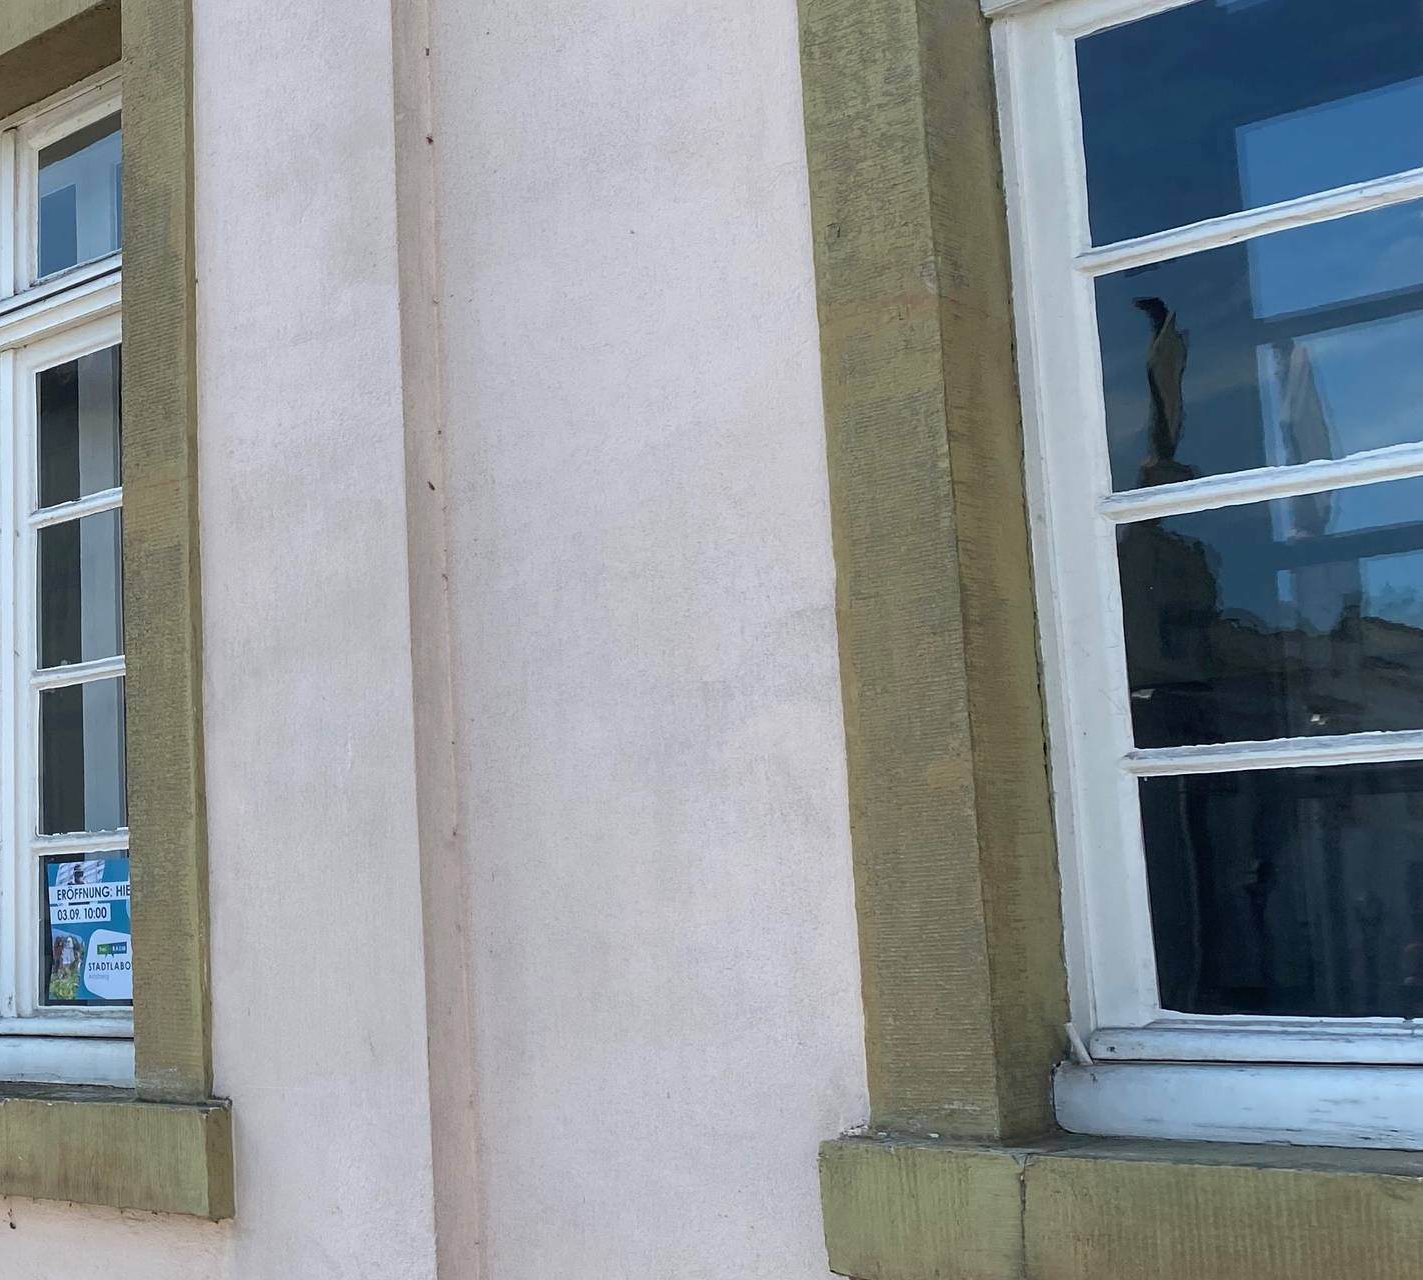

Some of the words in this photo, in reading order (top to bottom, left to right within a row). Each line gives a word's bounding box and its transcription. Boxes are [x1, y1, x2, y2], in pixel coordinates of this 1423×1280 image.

[57, 885, 113, 901] ERÖFFNUNG:
[57, 908, 81, 921] 03.09.
[84, 906, 107, 919] 10:00
[88, 961, 131, 972] STADTLABO
